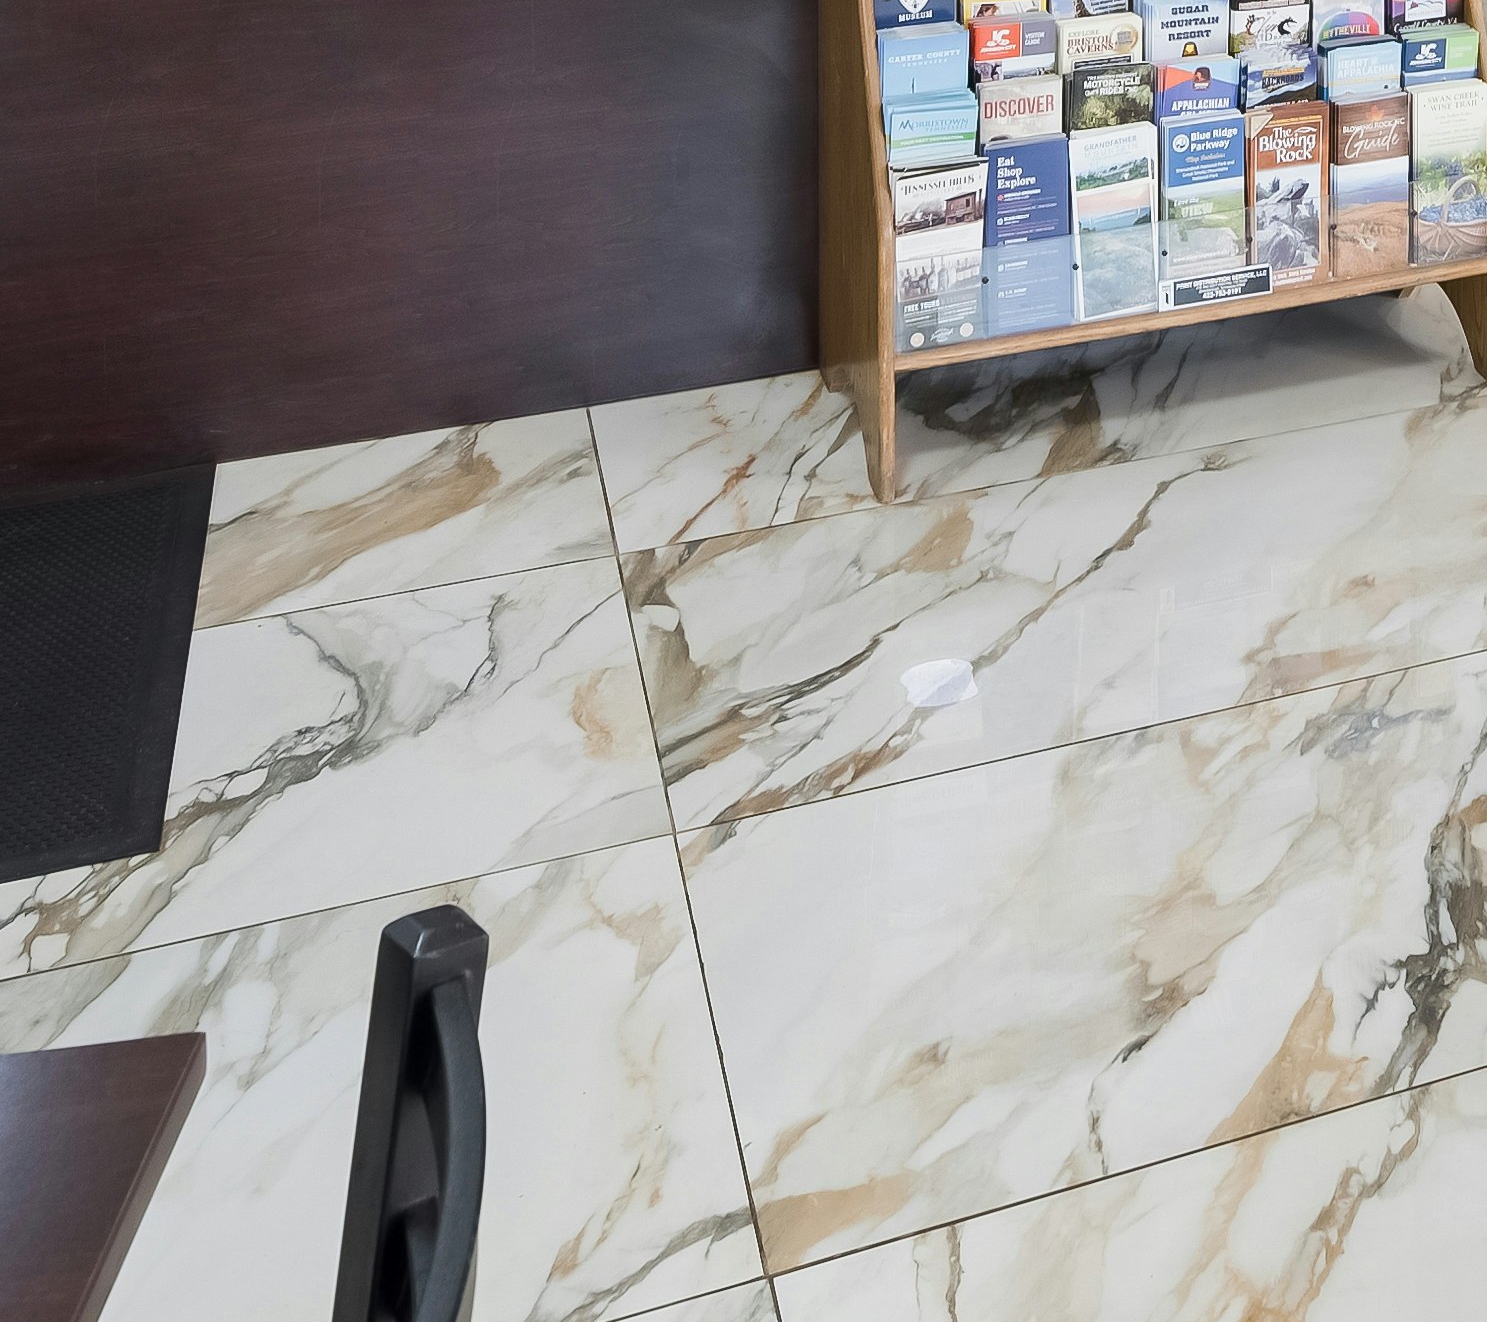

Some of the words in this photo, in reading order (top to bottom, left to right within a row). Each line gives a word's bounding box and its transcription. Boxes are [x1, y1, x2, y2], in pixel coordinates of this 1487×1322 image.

[898, 9, 933, 23] MUSEUM
[1171, 4, 1209, 15] SUGAR
[1160, 16, 1219, 30] MOUNTAIN
[1447, 17, 1458, 26] VA
[1068, 29, 1100, 38] EXPLORE
[1168, 29, 1212, 42] RESORT
[1067, 34, 1113, 48] BRISTOL
[888, 53, 923, 64] CARTER
[926, 48, 961, 59] COUNTY
[1066, 42, 1114, 56] CAVERNS
[1338, 57, 1369, 70] HEART
[1337, 64, 1395, 79] APPALACHIA
[1083, 76, 1141, 90] MOTORCYCLE
[1172, 98, 1230, 112] APPALACHIAN
[1427, 94, 1452, 104] SWAN
[1453, 92, 1480, 101] CREEK
[984, 94, 1055, 120] DISCOVER
[1430, 102, 1452, 112] WINE
[1455, 100, 1478, 109] TRAIL
[898, 116, 969, 132] MORRISTOWN
[1343, 121, 1375, 133] BLOWING
[1190, 131, 1211, 142] Blue
[1212, 127, 1238, 138] Ridge
[1273, 126, 1293, 139] The
[1084, 135, 1137, 152] GRANDFATHER
[1190, 139, 1230, 152] Parkway
[1260, 134, 1317, 153] Blowing
[1344, 123, 1400, 159] Guide
[997, 155, 1015, 168] Eat
[1276, 146, 1313, 164] Rock
[997, 167, 1023, 181] Shop
[903, 179, 947, 196] TENNESSEE
[948, 174, 975, 187] HILLS
[997, 176, 1037, 190] Explore
[903, 303, 919, 313] FREE
[920, 299, 941, 311] TOURS
